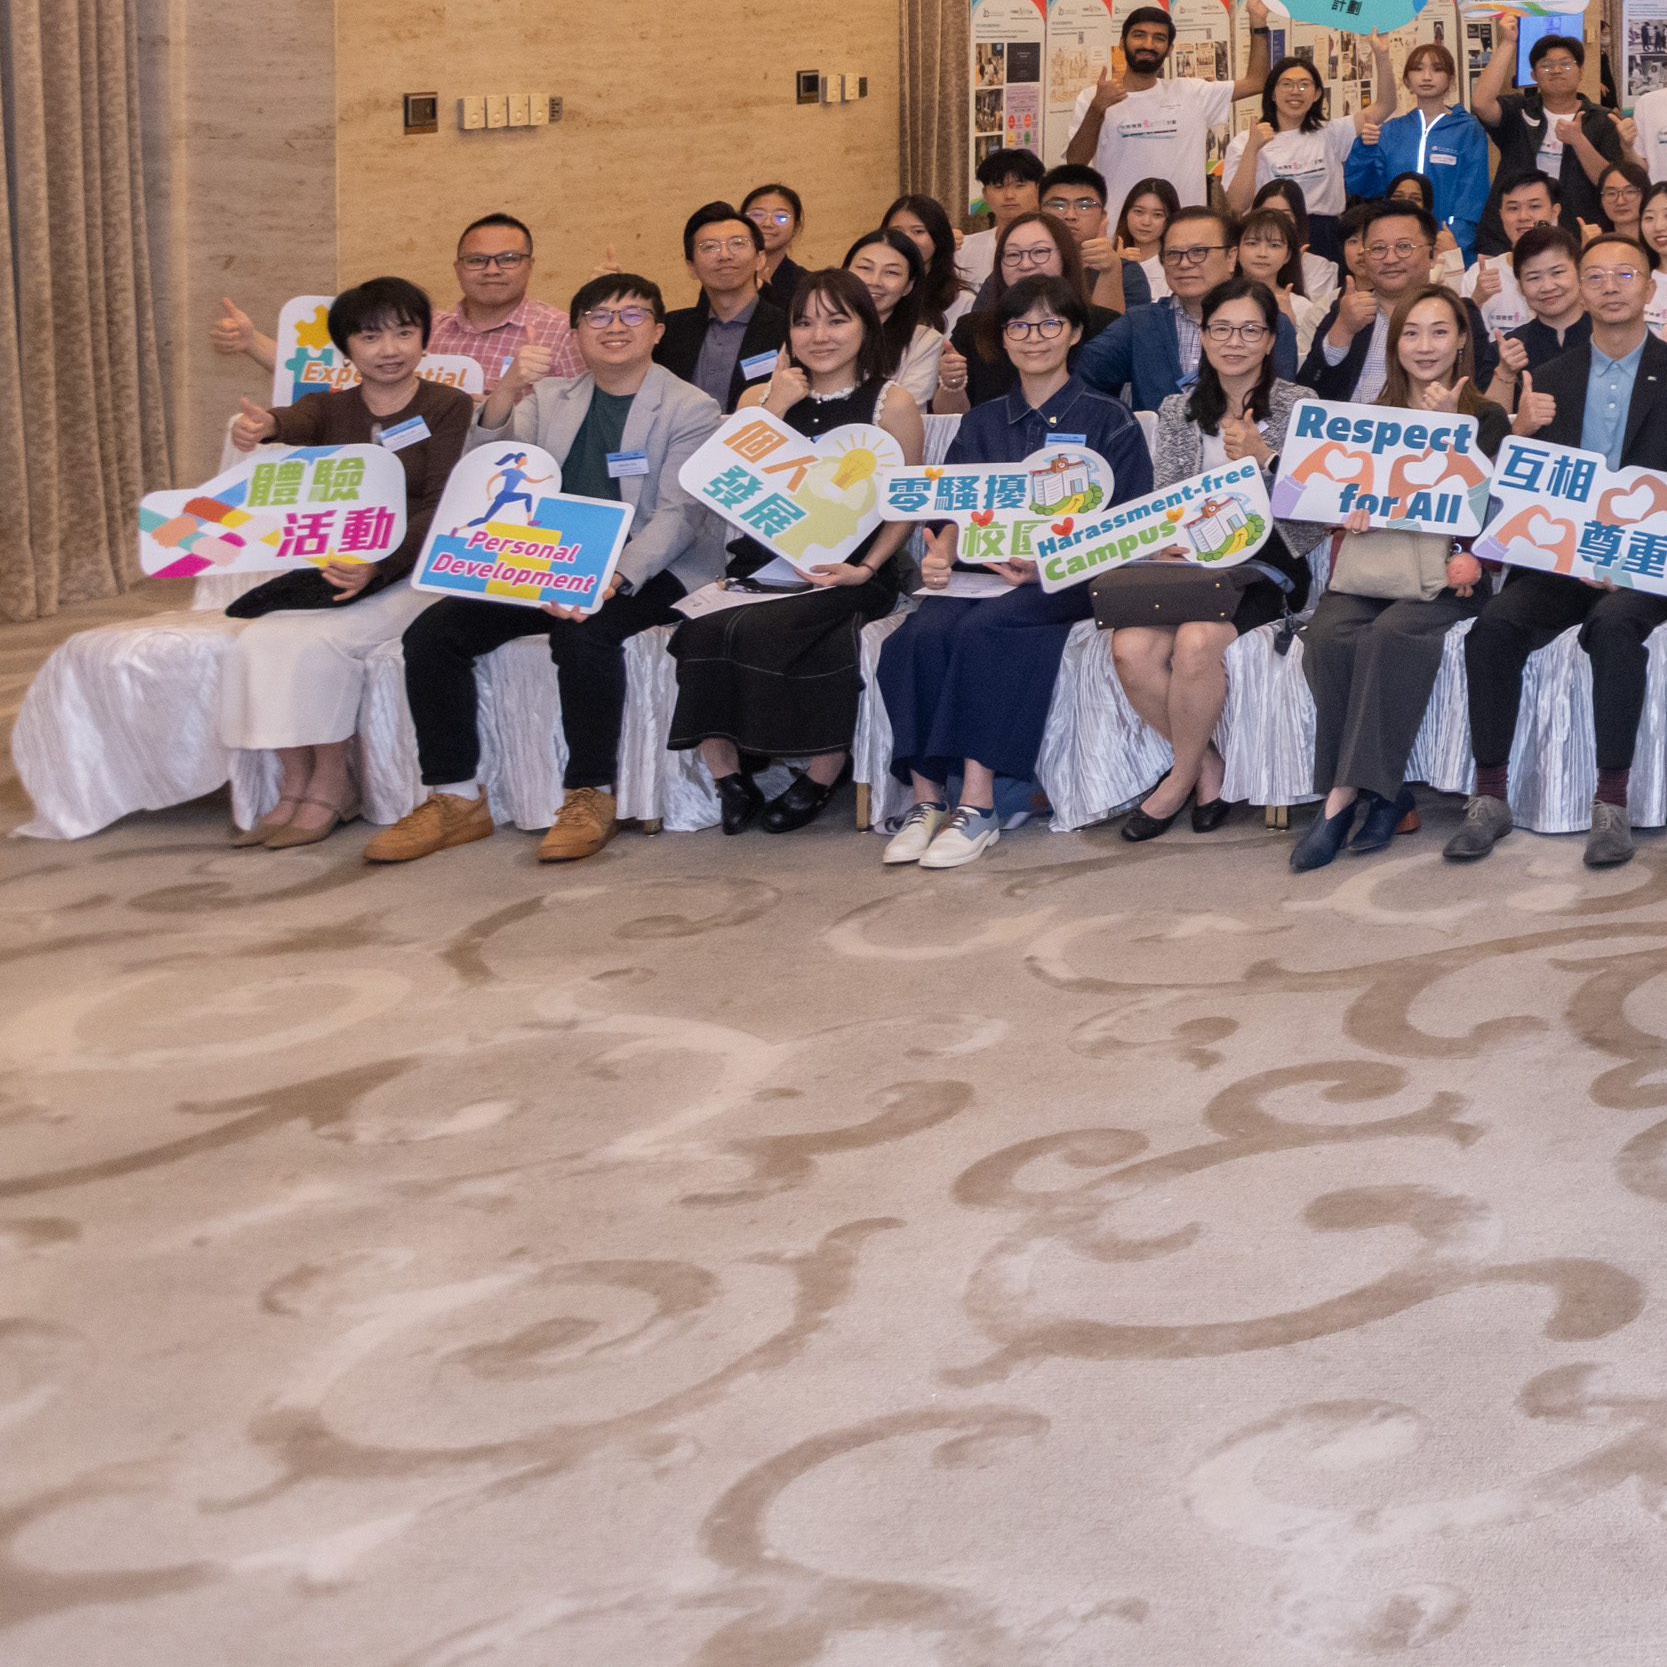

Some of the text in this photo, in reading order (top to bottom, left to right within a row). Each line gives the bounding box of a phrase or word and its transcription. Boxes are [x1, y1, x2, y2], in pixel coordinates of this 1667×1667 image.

[1294, 404, 1473, 455] Respect
[722, 419, 820, 493] 個人
[1499, 444, 1598, 503] 互相
[247, 457, 366, 508] 體驗
[702, 464, 808, 540] 發展
[887, 473, 1028, 513] 零騷擾
[1339, 483, 1463, 524] for All
[275, 505, 397, 558] 活動
[1037, 463, 1256, 558] Harassment-free
[466, 530, 581, 563] Personal
[1045, 518, 1177, 582] Campus
[430, 553, 597, 594] Development
